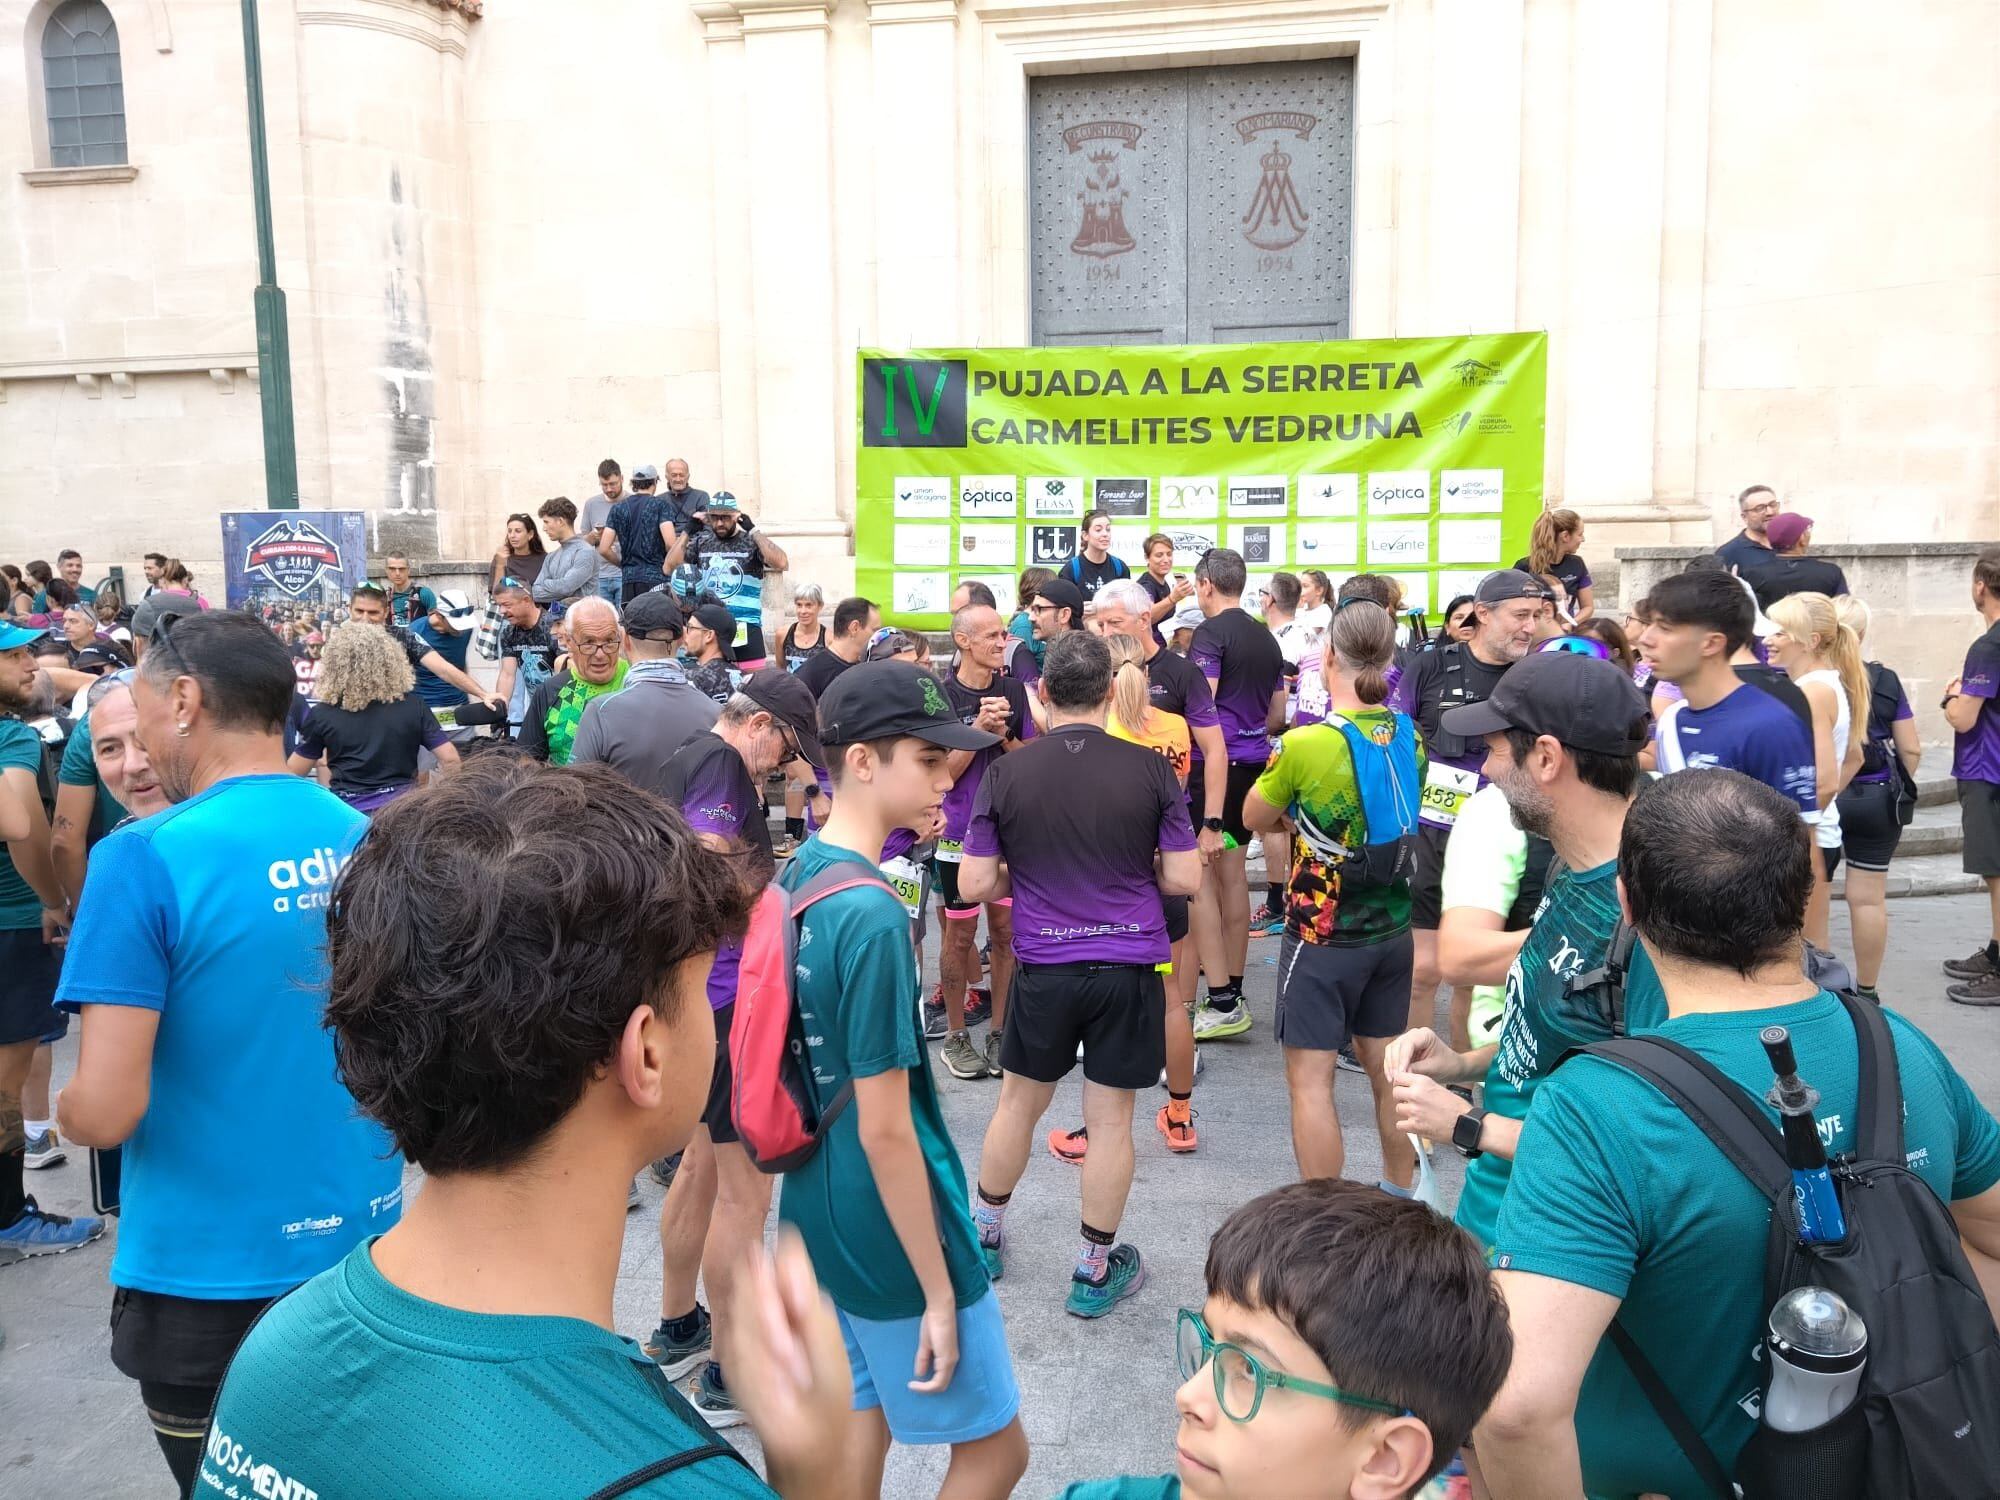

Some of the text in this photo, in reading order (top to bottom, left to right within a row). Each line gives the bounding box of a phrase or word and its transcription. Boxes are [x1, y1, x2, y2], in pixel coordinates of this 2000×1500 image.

[1257, 256, 1294, 272] 1954
[974, 361, 1425, 397] PUJADA A LA SERRETA
[881, 365, 949, 437] IV
[971, 411, 1424, 446] CARMELITES VEDRUNA
[1371, 536, 1425, 551] Levante
[283, 574, 305, 583] Alcoi
[1422, 784, 1457, 808] 458
[273, 896, 290, 913] a
[1040, 923, 1141, 937] RUNNERS
[1906, 1147, 1929, 1163] BRIDGE
